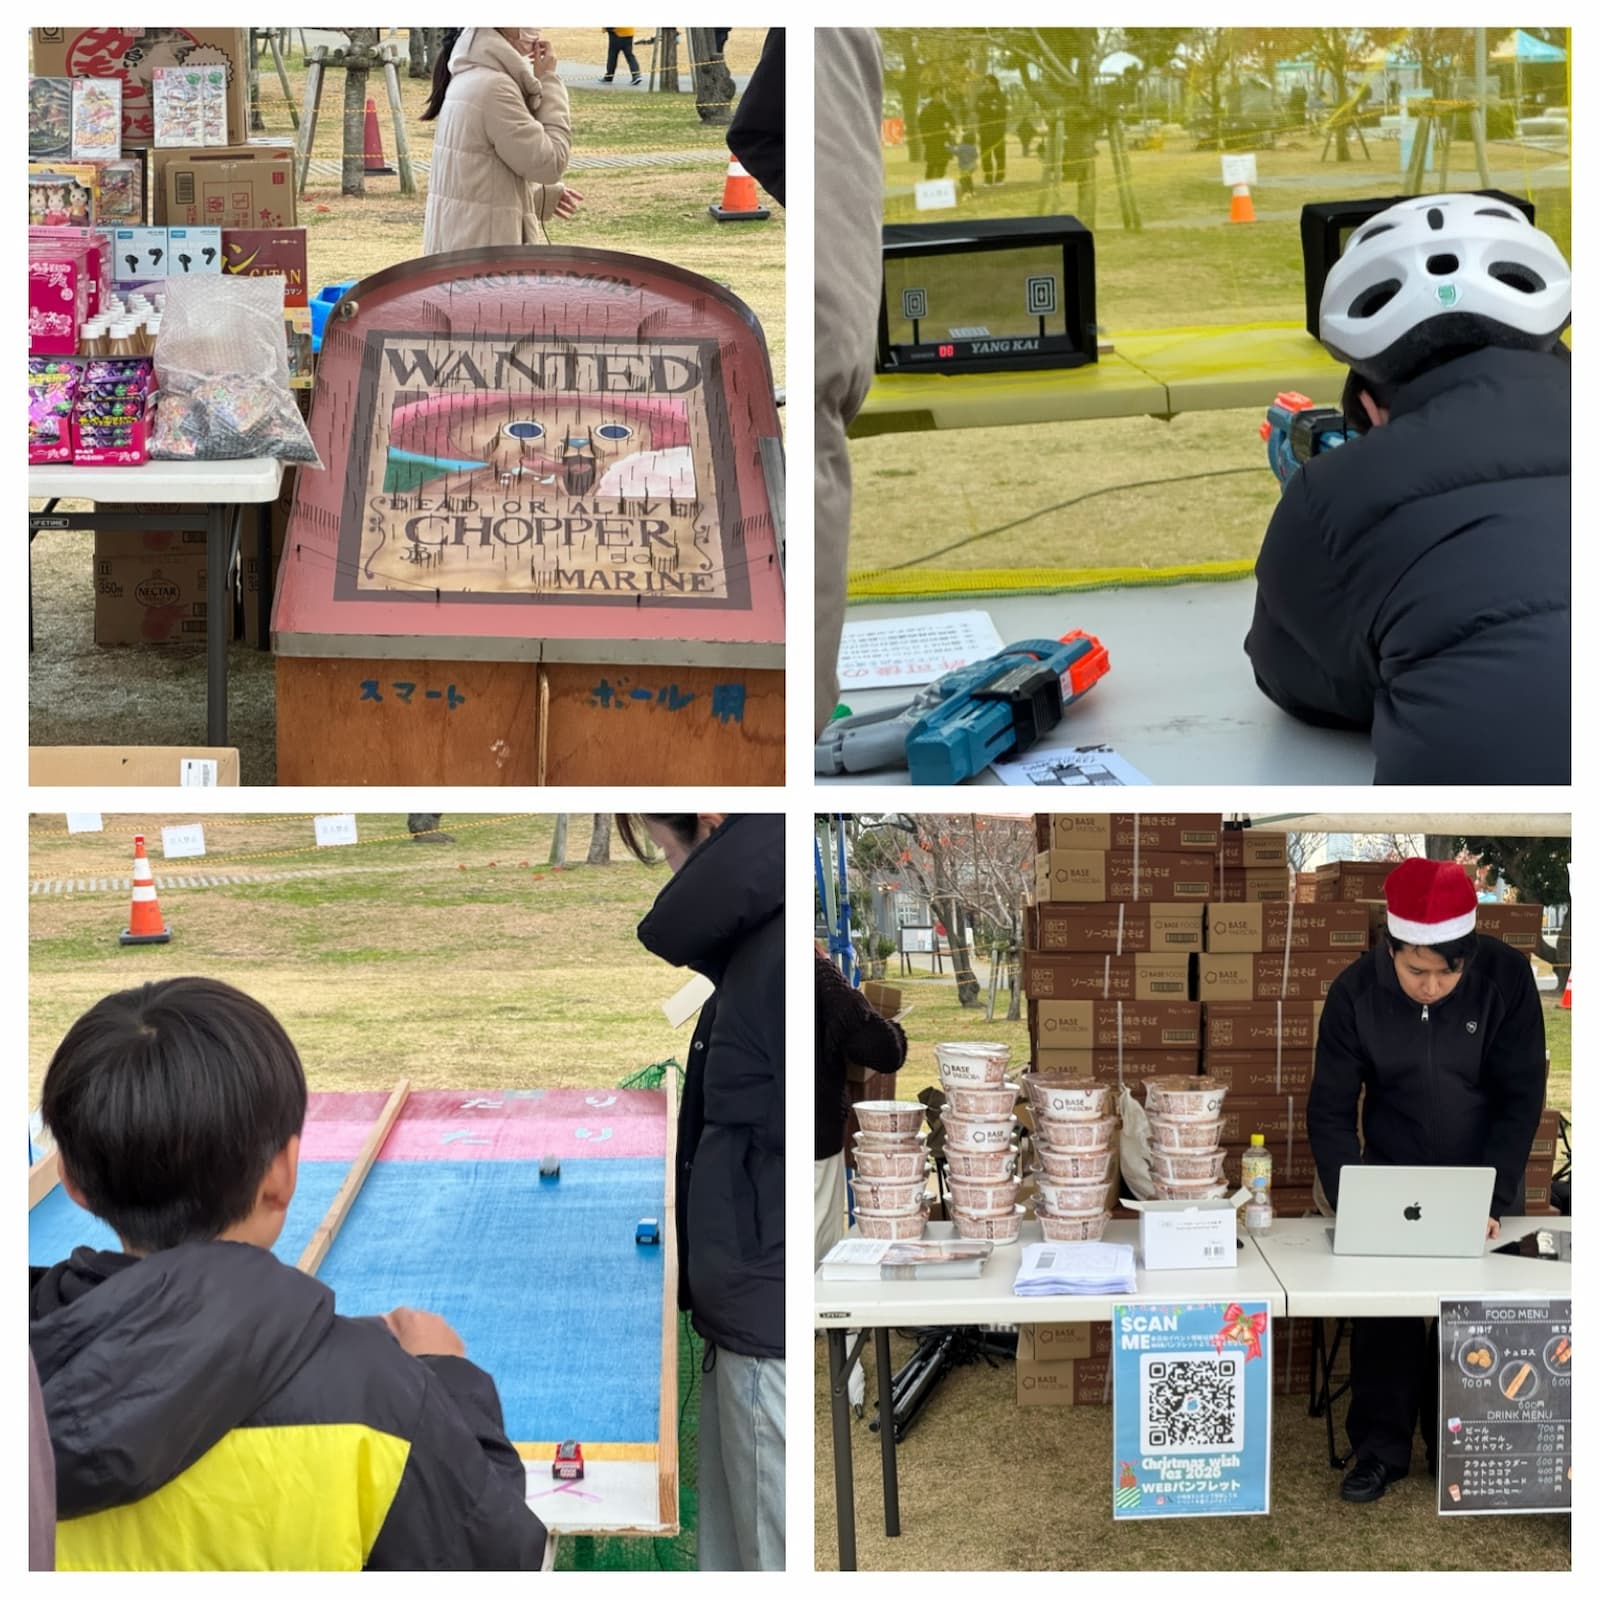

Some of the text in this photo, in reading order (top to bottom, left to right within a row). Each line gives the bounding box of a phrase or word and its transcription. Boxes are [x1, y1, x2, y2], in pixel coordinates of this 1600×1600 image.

[971, 339, 1040, 354] YANG KAI
[383, 347, 704, 393] WANTED
[389, 498, 700, 517] DEAD OR ALIVE
[404, 515, 675, 548] CHOPPER
[557, 568, 715, 593] MARINE
[359, 679, 465, 710] スマート
[1075, 817, 1095, 826] BASE
[1116, 816, 1177, 827] ソー焼きそば
[1070, 868, 1089, 877] BASE
[1228, 921, 1247, 929] BASE
[1219, 970, 1238, 978] BASE
[1071, 978, 1129, 988] ソース焼そば
[1058, 1018, 1079, 1026] BASE
[951, 1064, 970, 1073] BASE
[1058, 1065, 1078, 1073] BASE
[987, 1129, 1004, 1138] BASE
[1485, 1309, 1549, 1320] FOOD MENU
[1120, 1315, 1178, 1332] SCAN
[1055, 1329, 1075, 1337] BASE
[1120, 1334, 1150, 1350] ME
[1037, 1375, 1057, 1384] BASE
[1487, 1410, 1552, 1420] DRINK MENU
[1213, 1453, 1241, 1469] wish
[1141, 1480, 1241, 1494] WEBパンフレット
